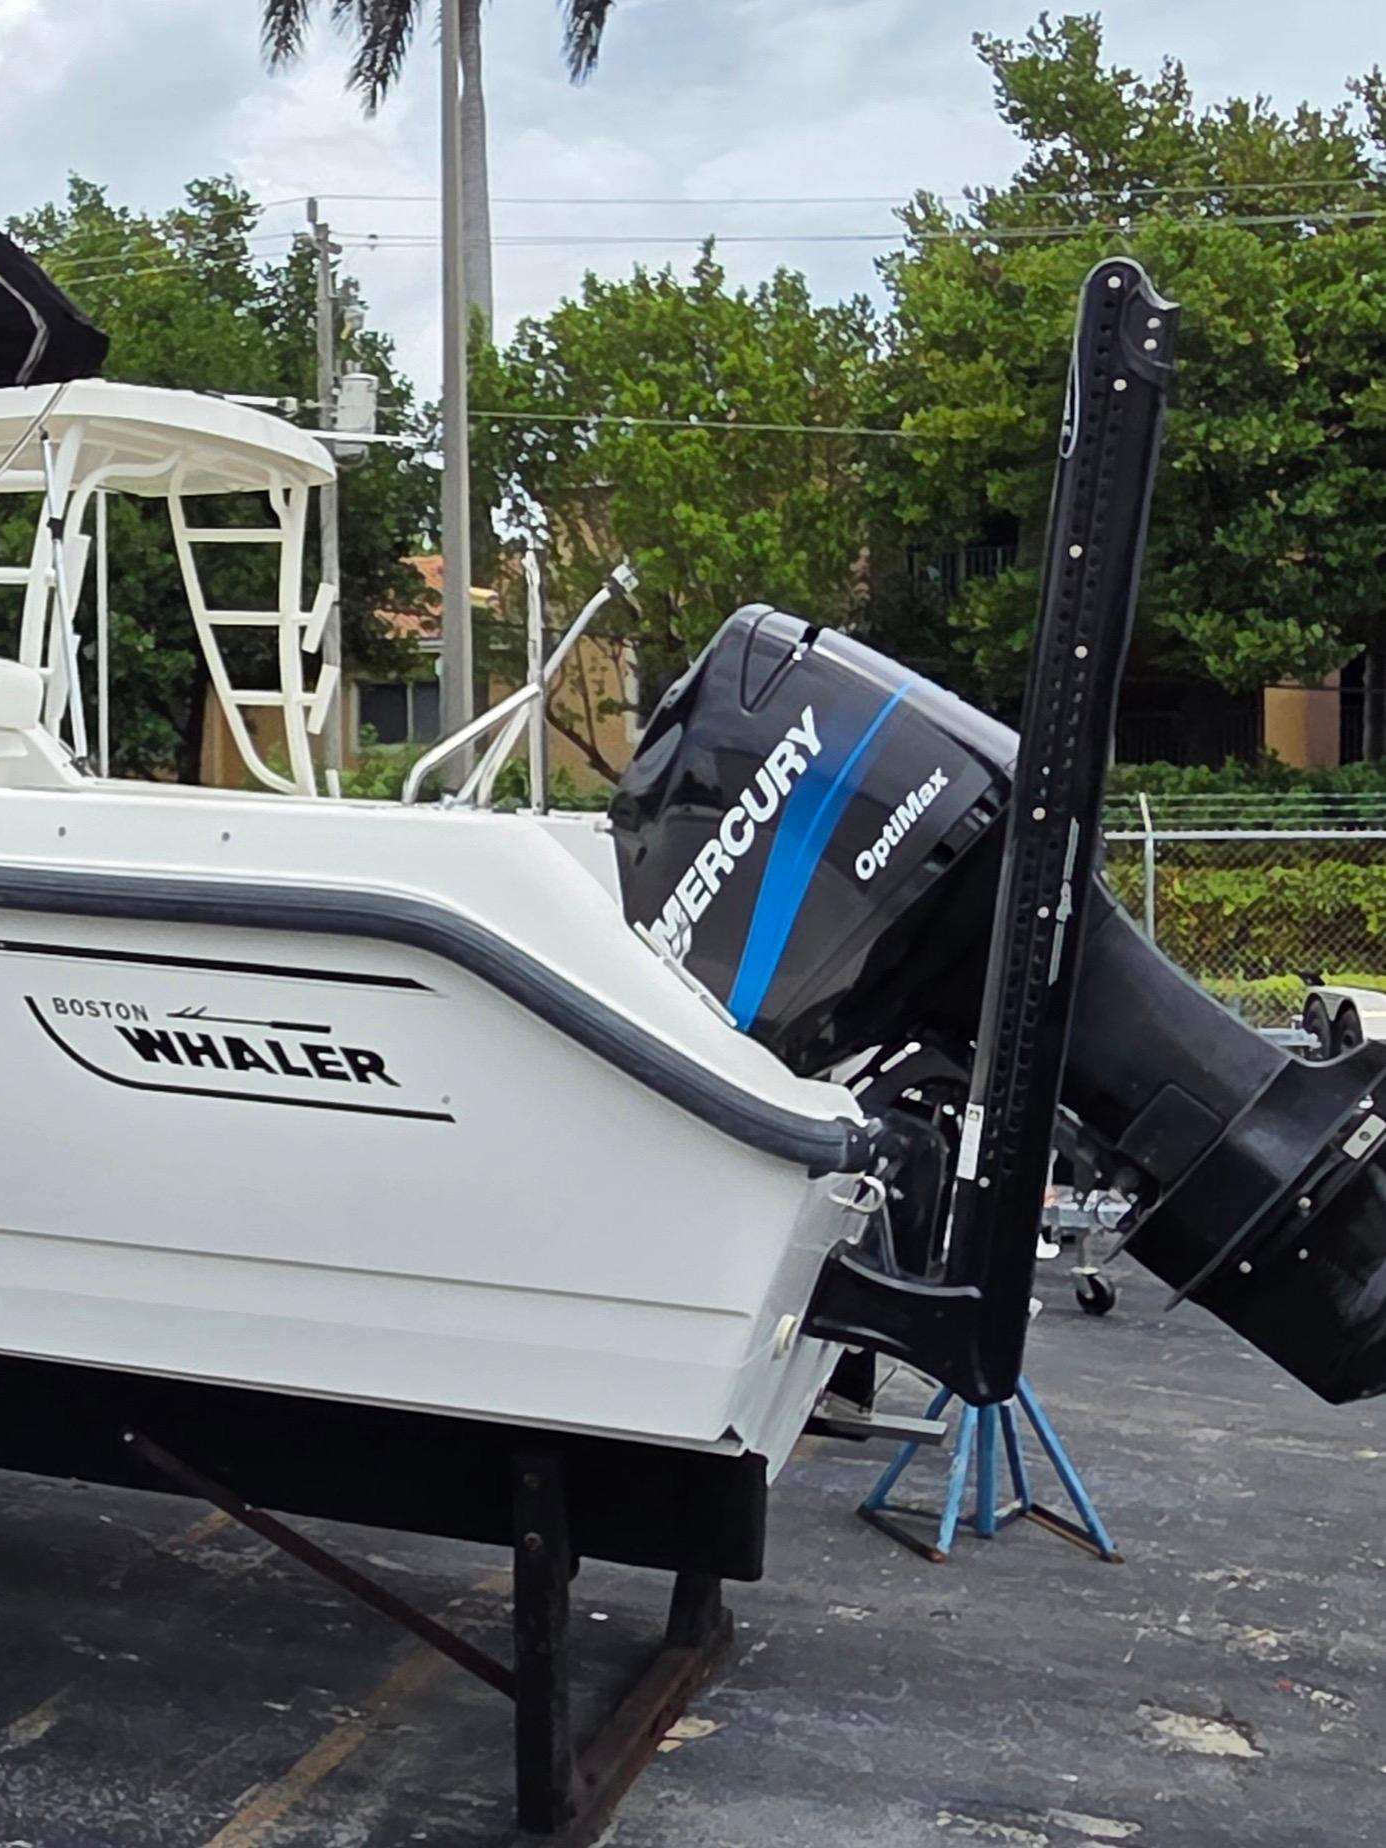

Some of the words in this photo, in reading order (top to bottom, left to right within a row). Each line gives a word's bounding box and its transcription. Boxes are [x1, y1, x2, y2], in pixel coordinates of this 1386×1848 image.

[648, 705, 822, 961] MERCURY
[52, 997, 149, 1022] BOSTON
[114, 1025, 401, 1088] WHALER
